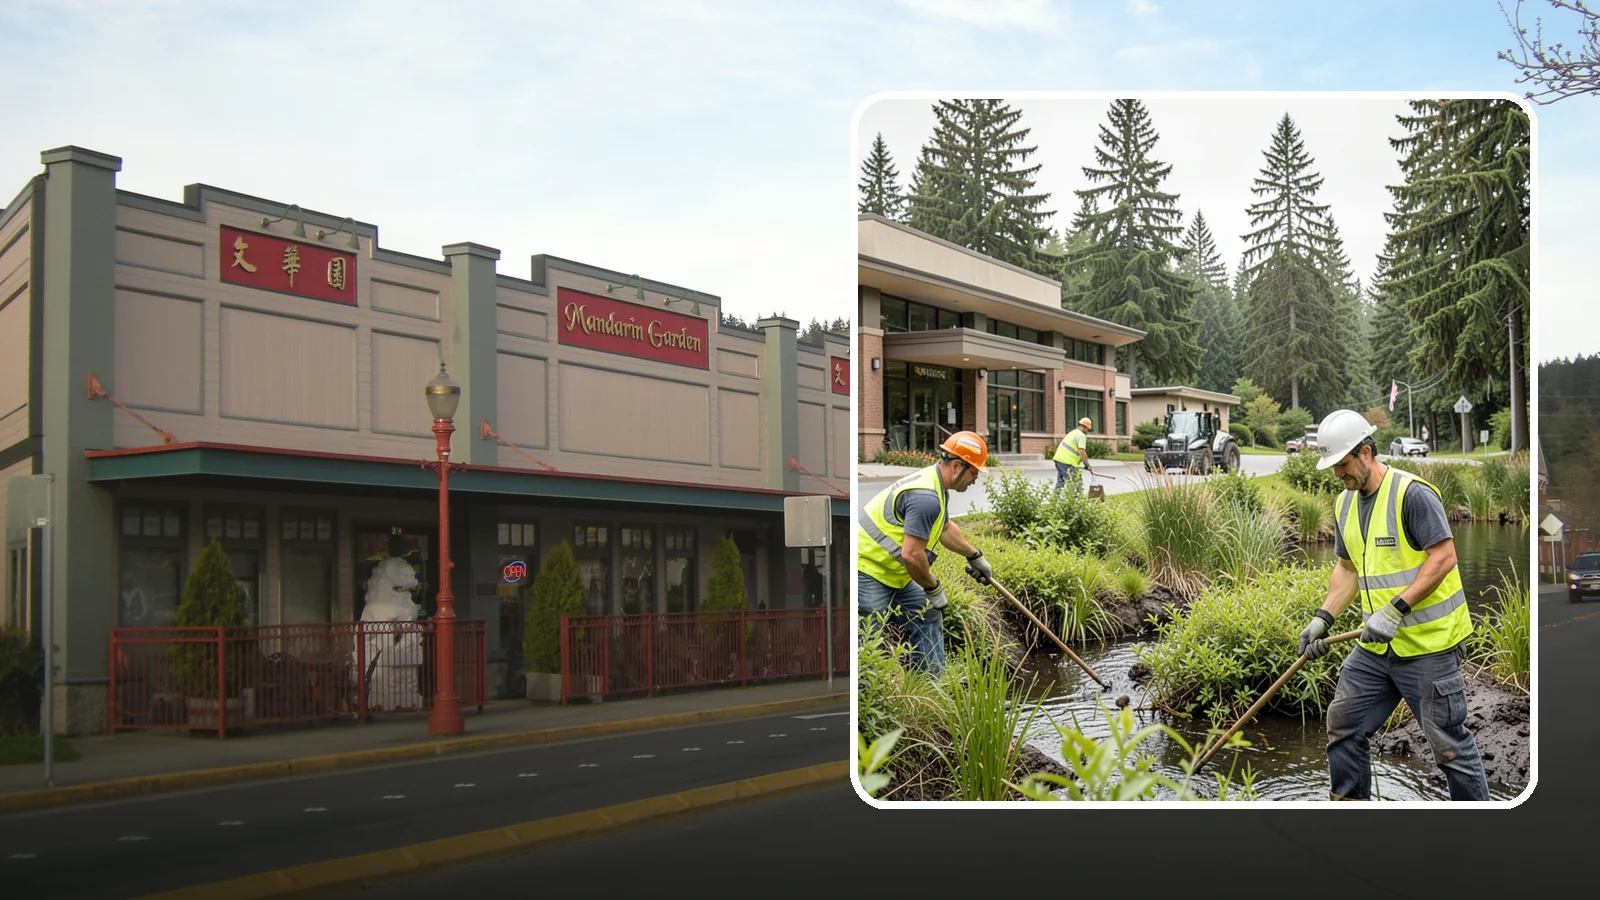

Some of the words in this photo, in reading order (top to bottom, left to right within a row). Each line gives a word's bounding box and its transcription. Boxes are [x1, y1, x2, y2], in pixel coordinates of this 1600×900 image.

[231, 235, 346, 291] 文華園
[565, 302, 644, 340] Mandarin
[648, 320, 701, 352] Garden
[503, 565, 527, 578] OPEN
